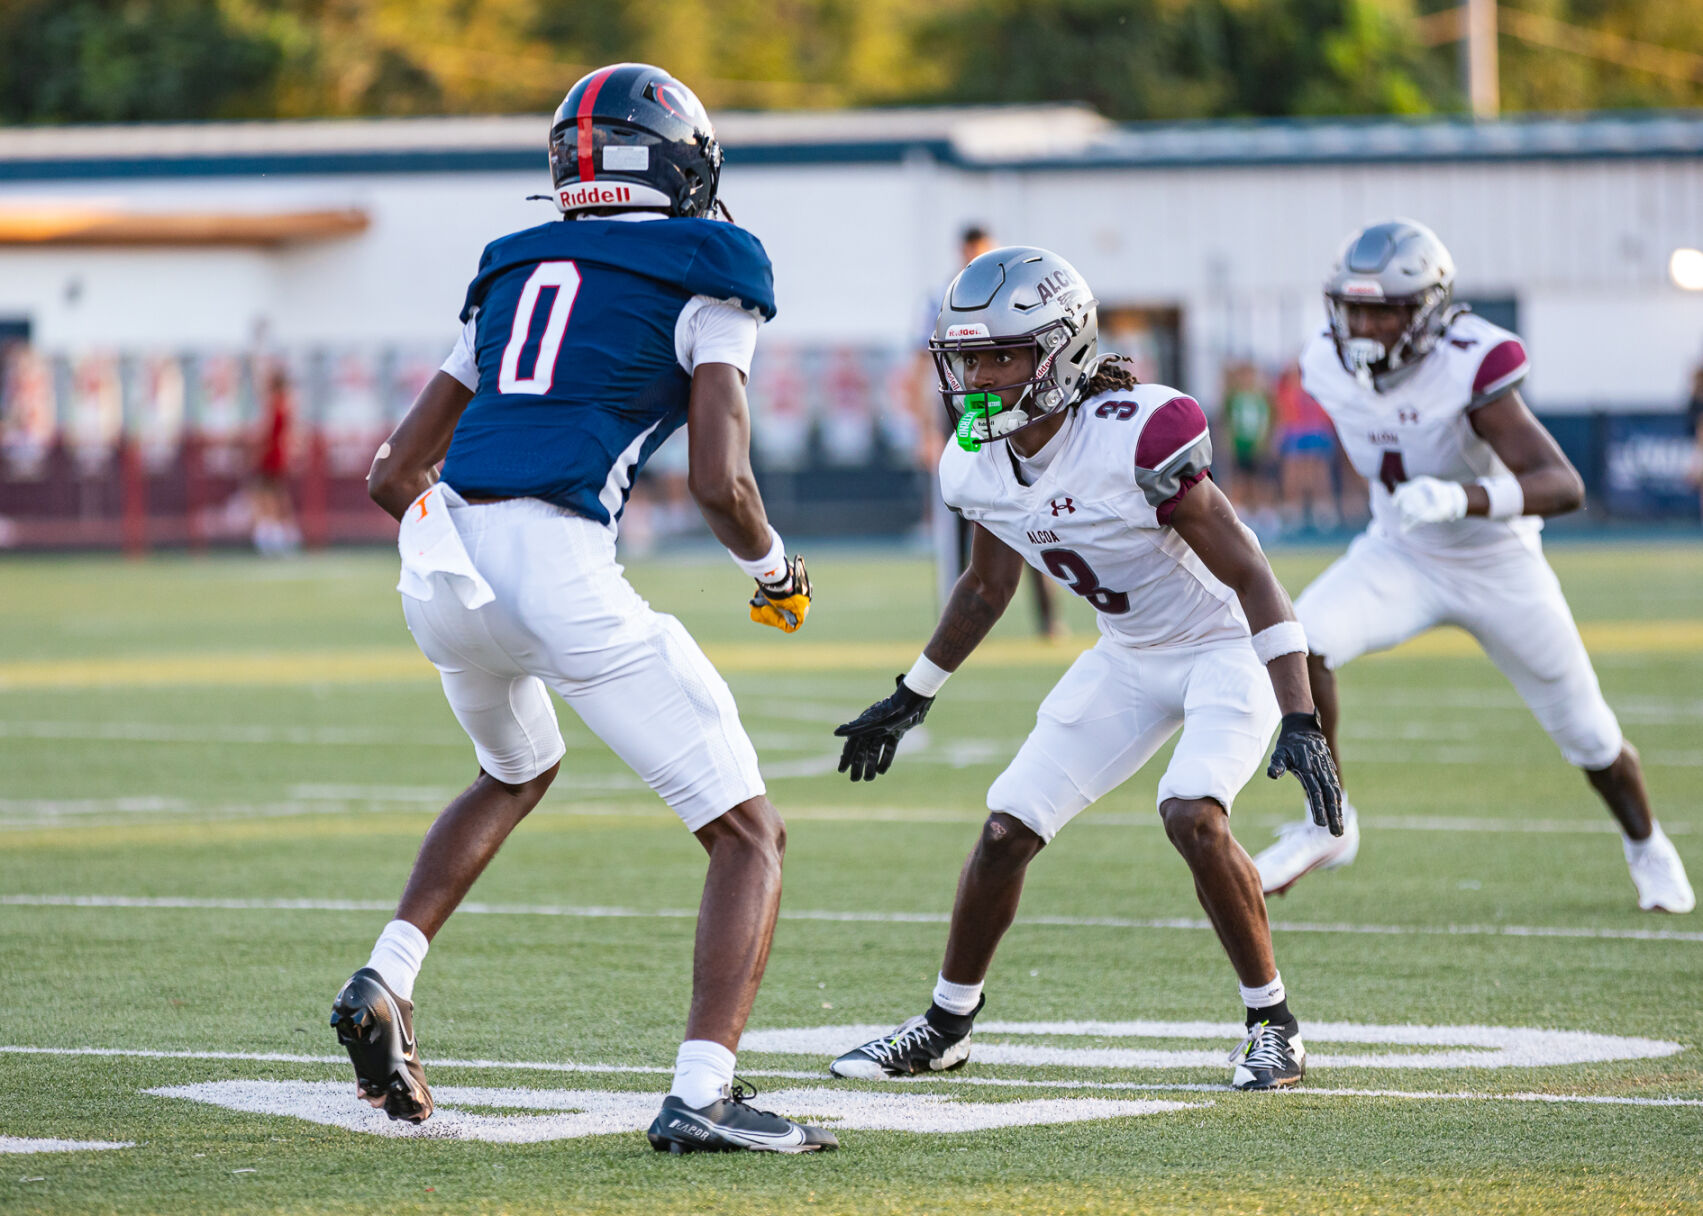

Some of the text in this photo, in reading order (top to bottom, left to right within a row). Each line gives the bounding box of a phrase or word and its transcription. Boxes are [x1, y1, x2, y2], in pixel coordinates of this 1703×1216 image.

[560, 187, 631, 208] Riddell
[497, 260, 583, 396] 0
[1095, 400, 1139, 421] 3
[410, 490, 433, 523] T
[1026, 530, 1060, 544] ALCOA
[1040, 548, 1130, 615] 3
